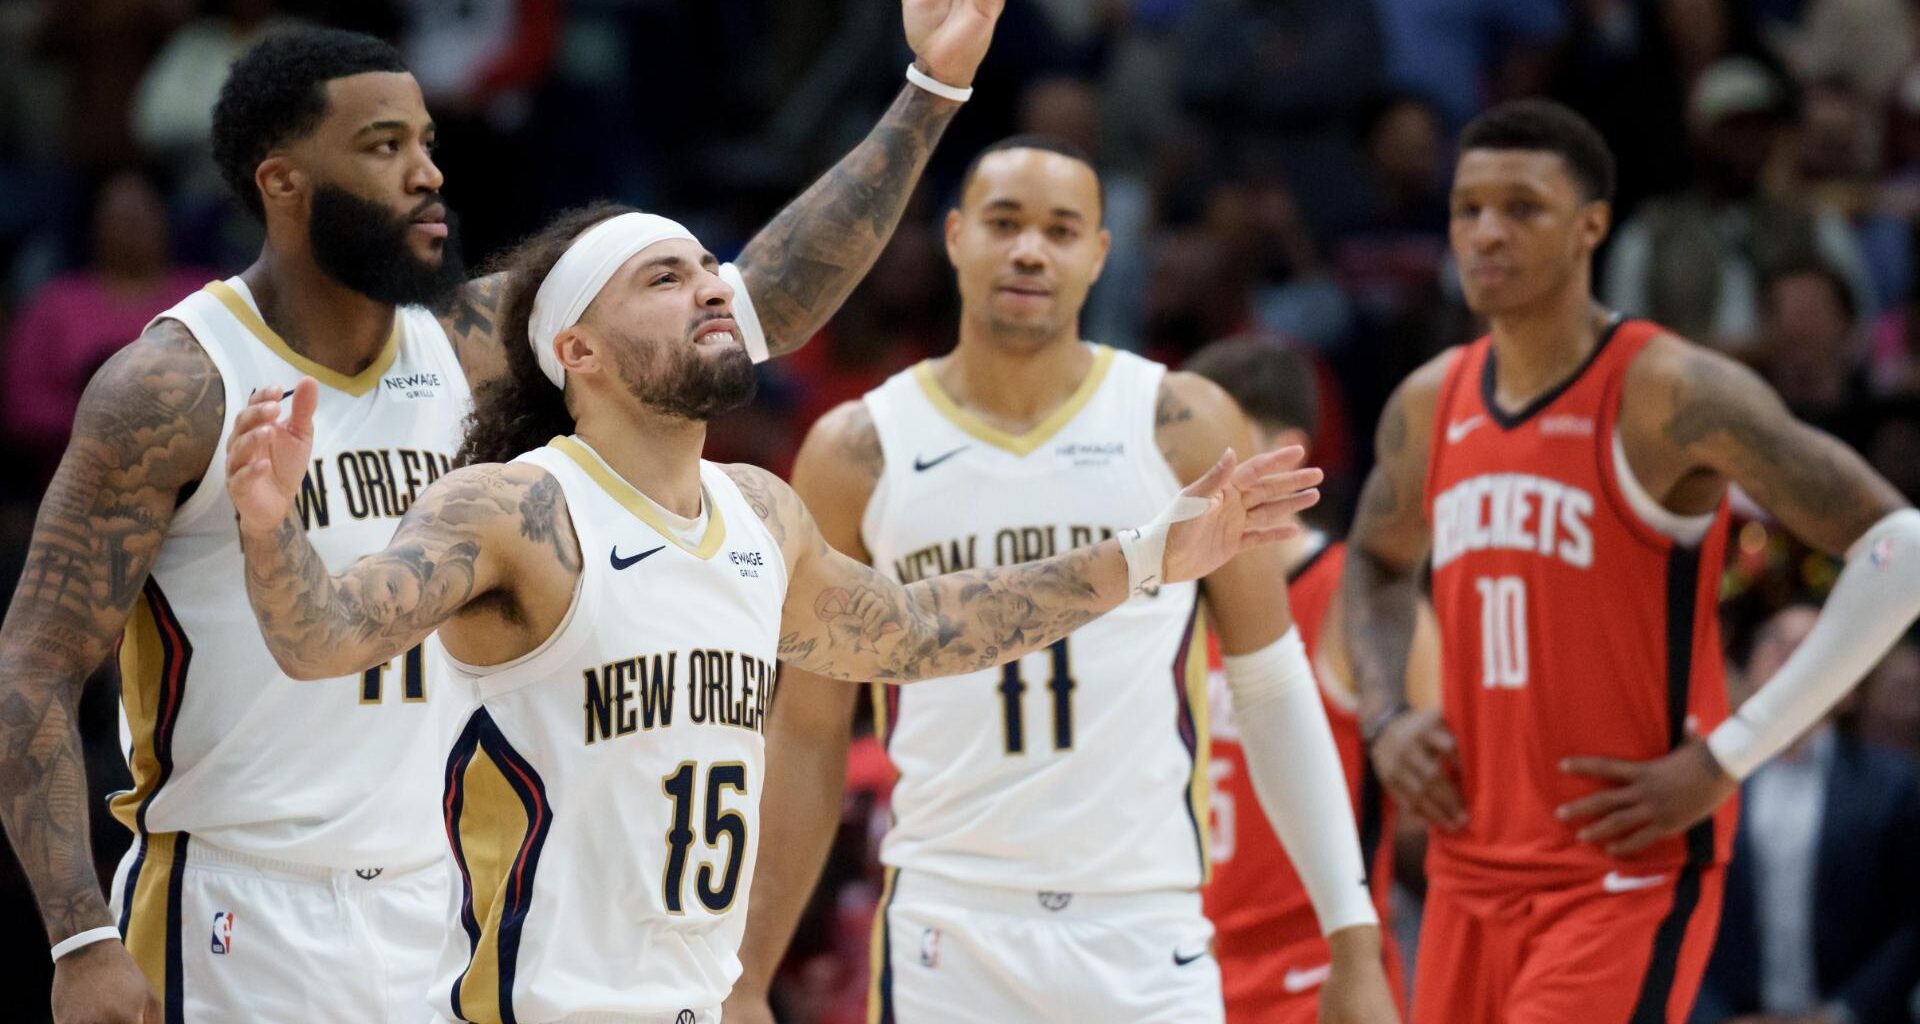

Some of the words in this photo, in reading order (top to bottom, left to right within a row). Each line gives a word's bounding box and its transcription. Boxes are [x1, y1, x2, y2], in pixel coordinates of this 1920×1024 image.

[1432, 471, 1595, 570] ROCKETS
[1475, 575, 1529, 690] 10
[583, 650, 678, 746] NEW
[995, 635, 1078, 757] 11
[661, 760, 748, 916] 15
